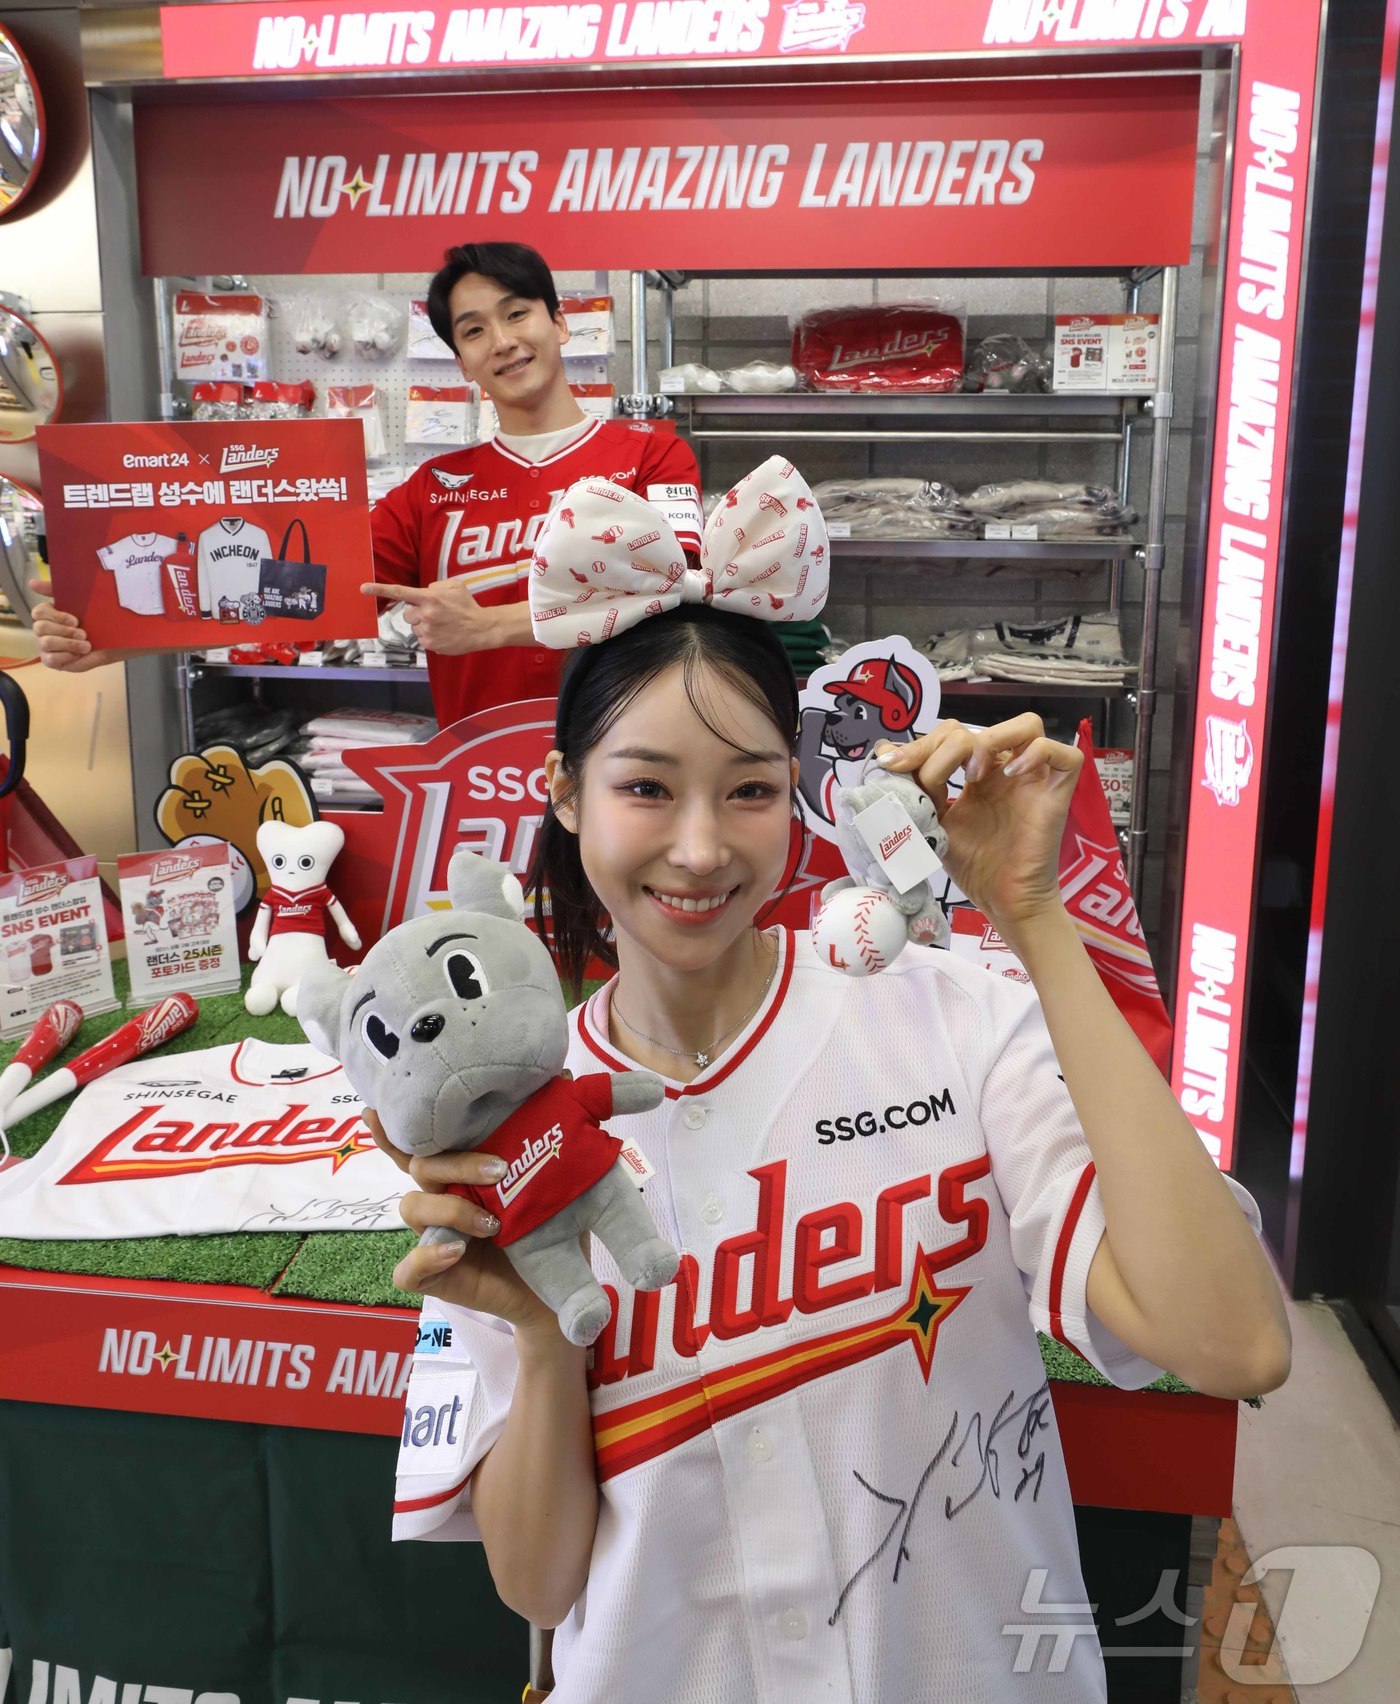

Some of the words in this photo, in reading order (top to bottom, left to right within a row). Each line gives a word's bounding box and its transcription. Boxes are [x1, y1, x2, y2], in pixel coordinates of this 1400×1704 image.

[438, 4, 602, 63] AMAZING
[605, 0, 770, 58] LANDERS
[548, 143, 790, 212] AMAZING
[798, 138, 1044, 208] LANDERS
[827, 326, 950, 372] Landers
[1223, 323, 1282, 521] AMAZING
[123, 453, 190, 468] emart24
[219, 445, 280, 474] Landers
[158, 480, 226, 506] 성수에
[229, 476, 348, 505] 랜더스왔쓱!
[587, 485, 624, 503] LANDERS
[209, 544, 260, 562] INCHEON
[627, 530, 661, 551] LANDERS
[752, 530, 785, 550] LANDERS
[793, 523, 809, 558] LANDERS
[534, 606, 567, 622] LANDERS
[1210, 522, 1267, 707] LANDERS
[879, 824, 912, 861] Landers
[150, 857, 201, 886] Landers
[16, 873, 68, 907] Landers
[1, 919, 35, 938] SNS
[38, 905, 92, 928] EVENT
[277, 904, 313, 918] Landers
[146, 954, 181, 967] 랜더스
[183, 944, 222, 961] 25시즌
[151, 963, 196, 979] 포토카드
[198, 957, 221, 971] 증정
[123, 1088, 239, 1104] SHINSEGAE
[815, 1088, 956, 1145] SSG.COM
[620, 1147, 648, 1175] Landers
